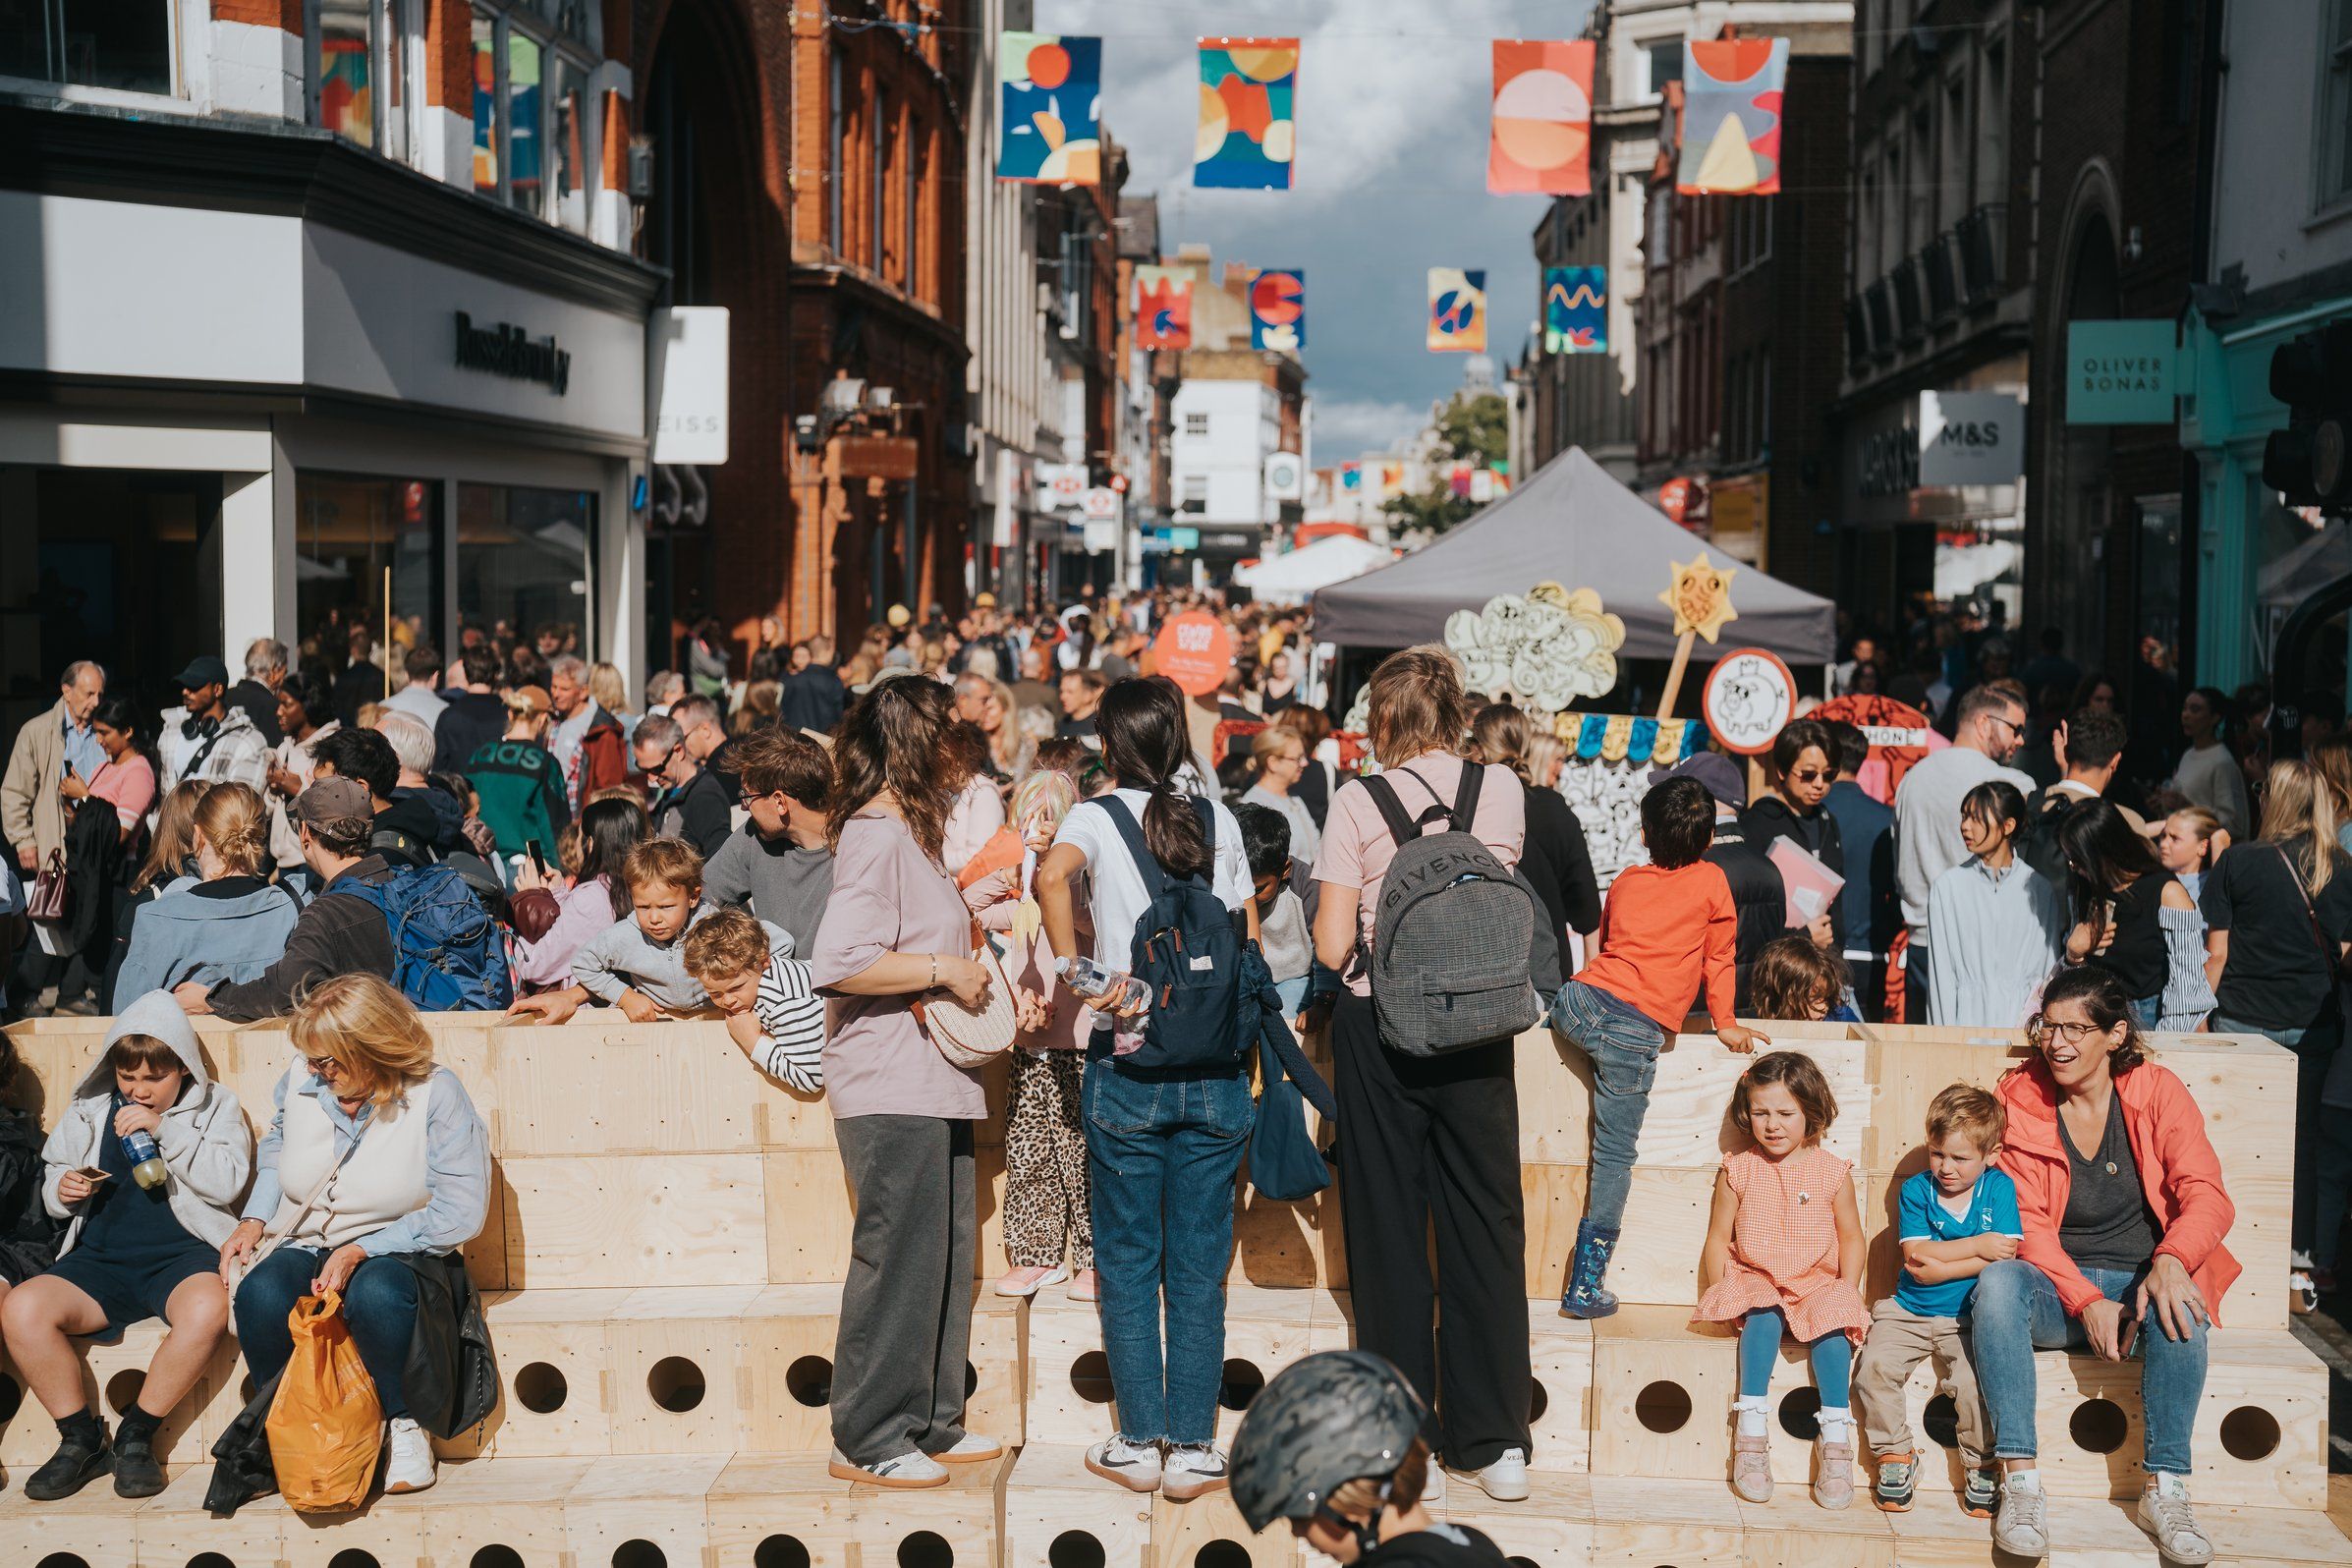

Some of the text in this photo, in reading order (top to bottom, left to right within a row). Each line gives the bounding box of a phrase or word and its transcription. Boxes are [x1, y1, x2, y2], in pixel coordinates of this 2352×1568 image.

[2084, 358, 2161, 374] OLIVER
[2084, 376, 2161, 393] BONAS
[1941, 420, 1999, 447] M&S
[1143, 1453, 1159, 1462] NIKE
